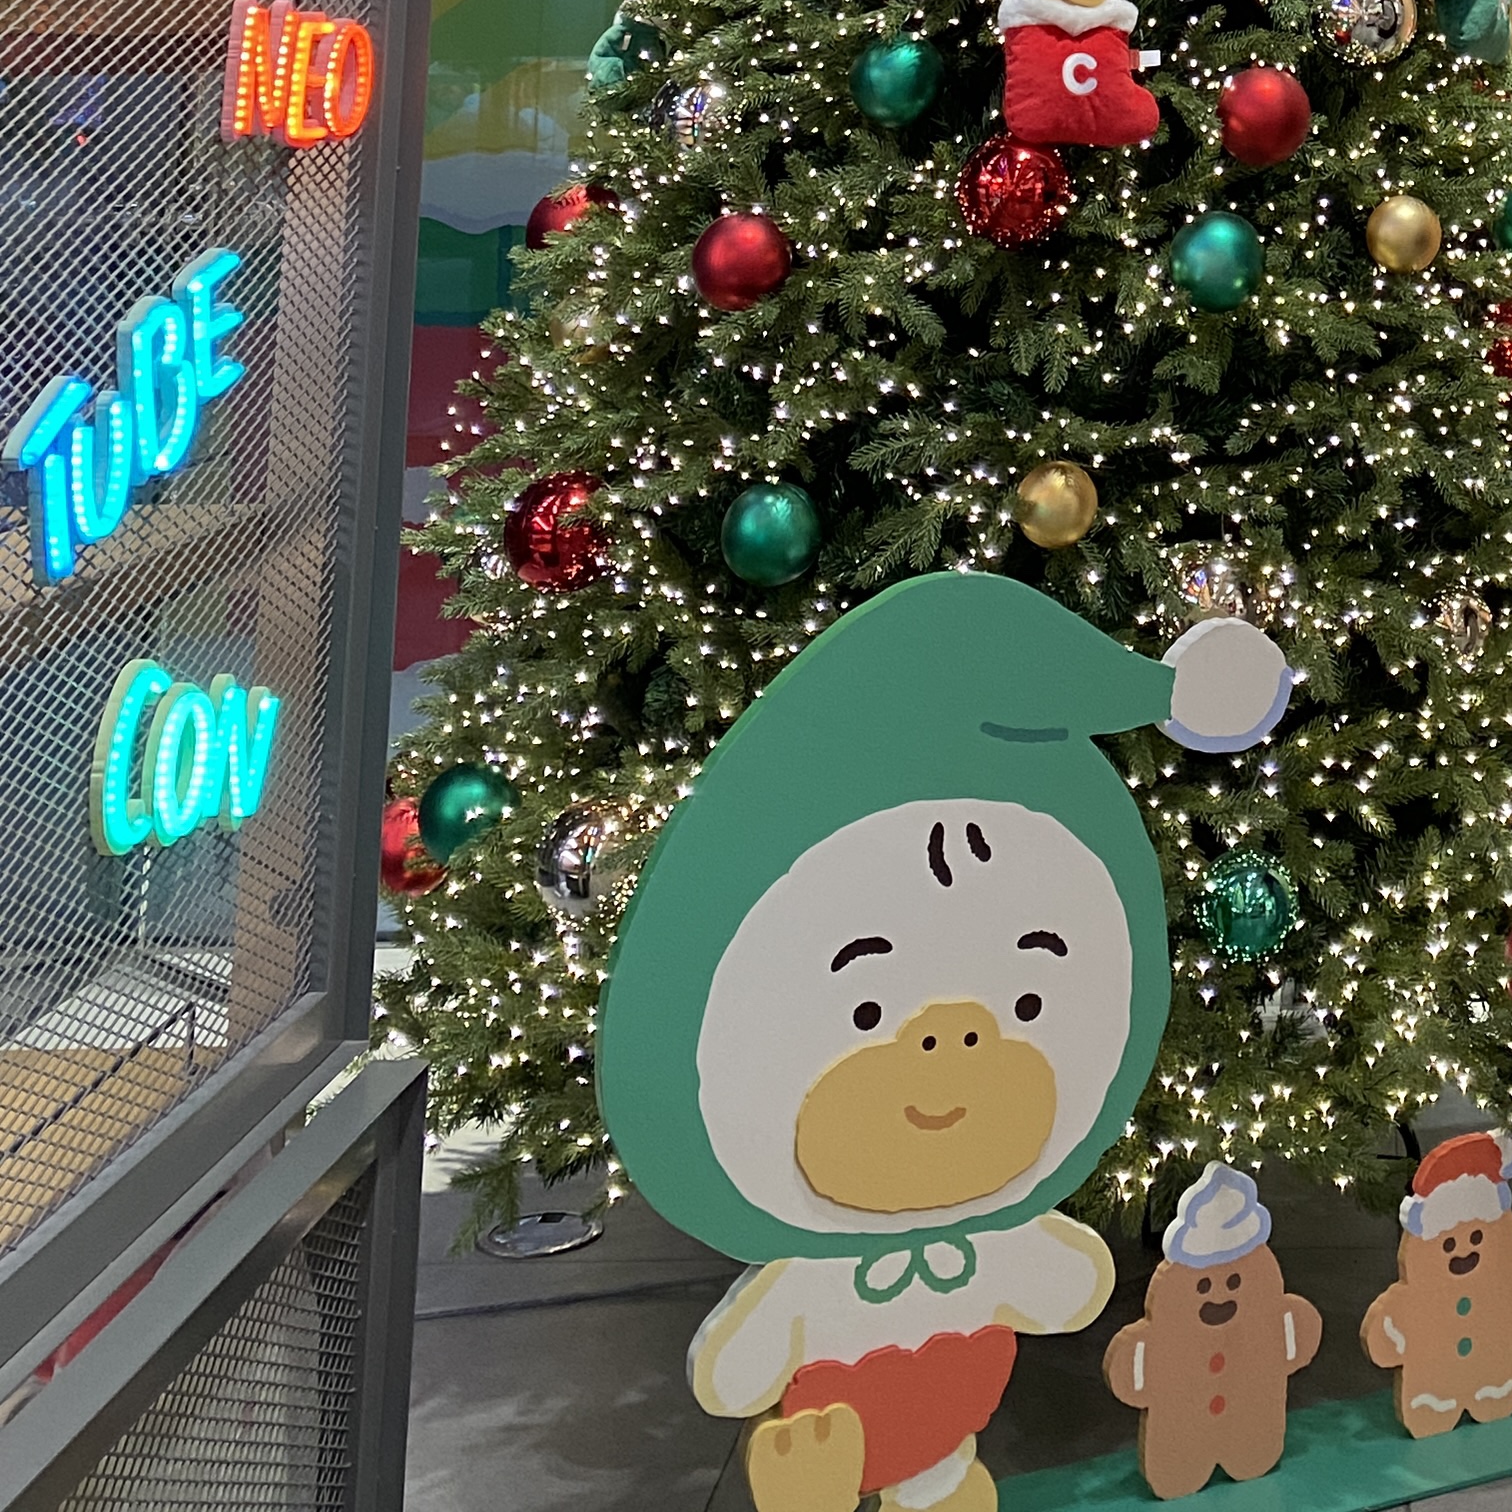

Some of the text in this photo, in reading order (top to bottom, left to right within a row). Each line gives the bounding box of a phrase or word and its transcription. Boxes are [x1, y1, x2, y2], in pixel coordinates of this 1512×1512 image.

[1061, 52, 1098, 97] C
[4, 248, 247, 585] TUBE
[90, 658, 281, 855] CON
